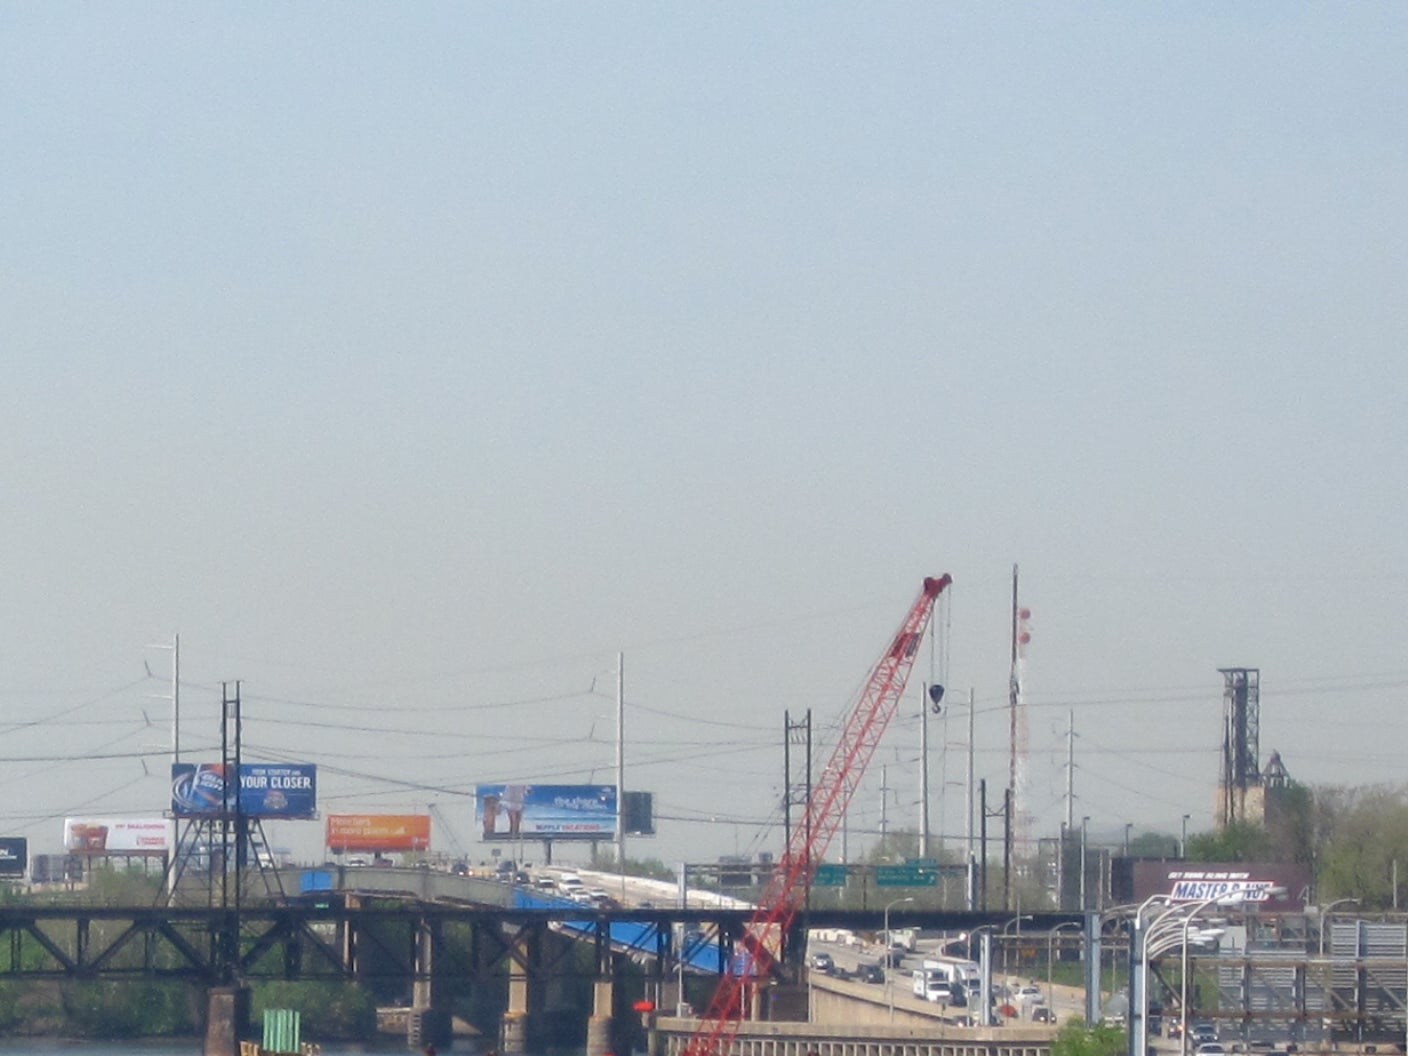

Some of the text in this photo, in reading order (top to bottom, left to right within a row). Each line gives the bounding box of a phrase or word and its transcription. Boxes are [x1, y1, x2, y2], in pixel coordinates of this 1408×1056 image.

[240, 776, 312, 789] YOUR CLOSER
[1175, 883, 1229, 898] MASTER
